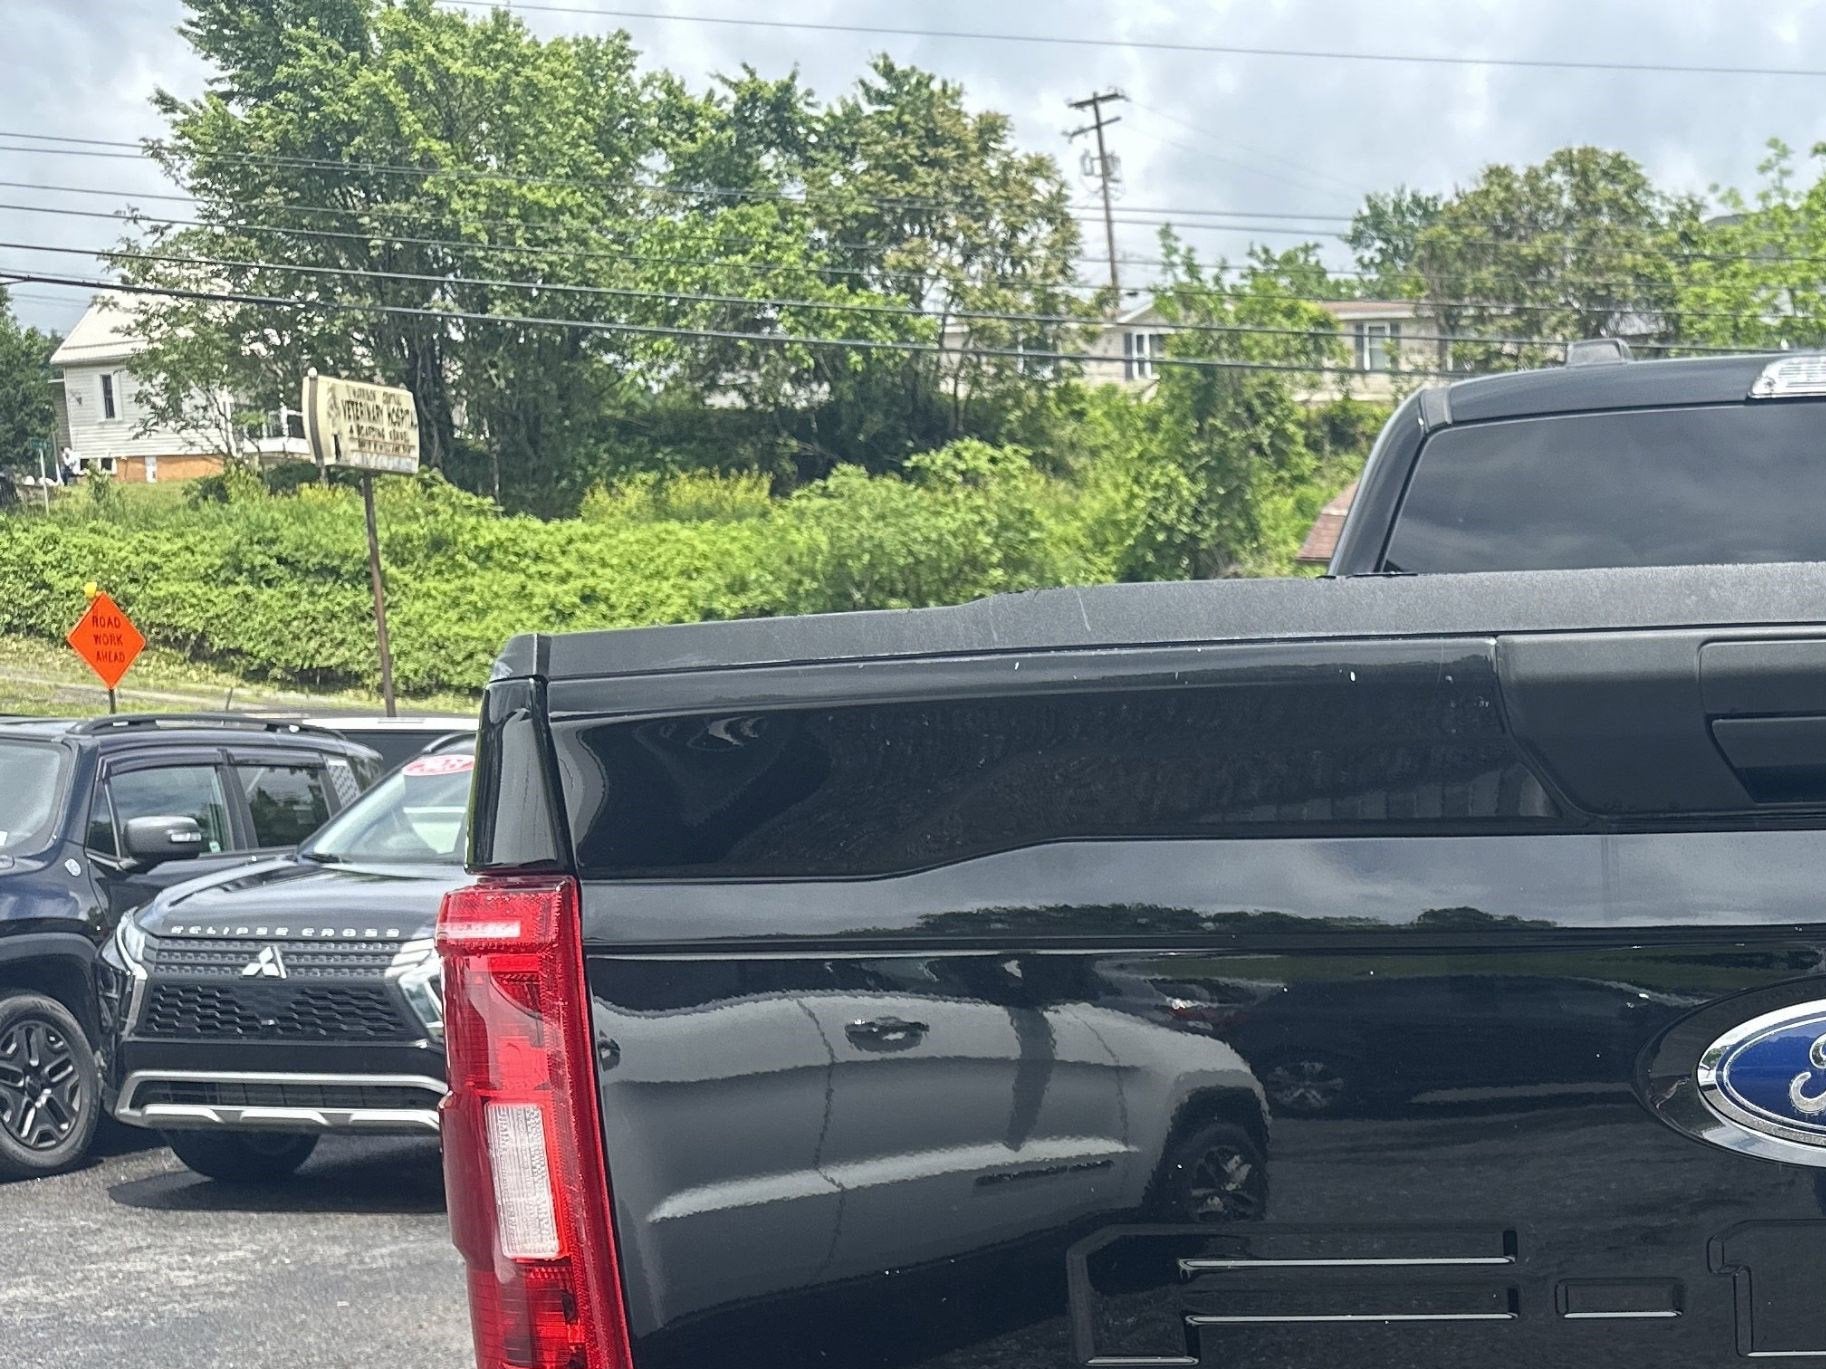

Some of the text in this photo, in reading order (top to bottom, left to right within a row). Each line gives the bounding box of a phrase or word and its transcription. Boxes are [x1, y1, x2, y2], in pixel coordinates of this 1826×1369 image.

[92, 615, 121, 629] ROAD
[93, 633, 123, 646] WORK
[96, 650, 126, 663] AHEAD
[301, 926, 400, 938] CROSS
